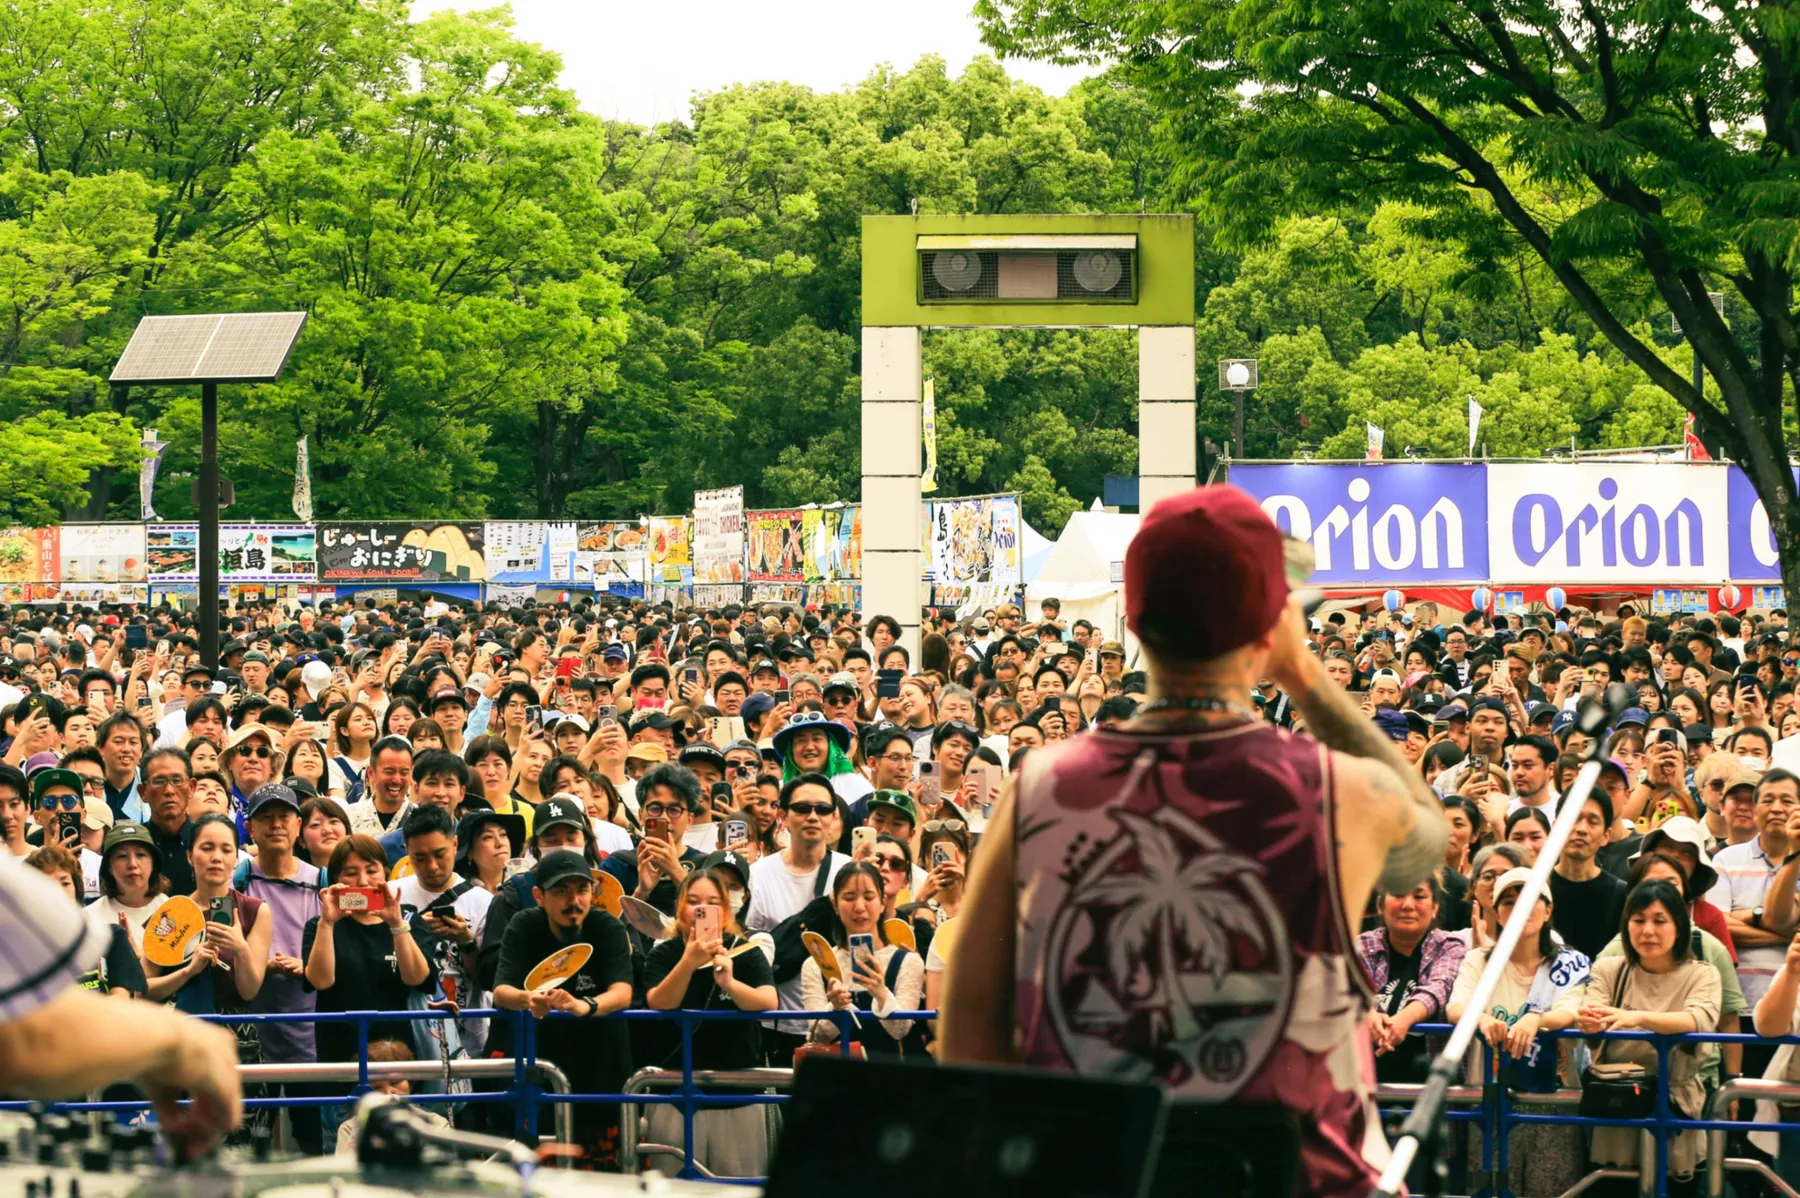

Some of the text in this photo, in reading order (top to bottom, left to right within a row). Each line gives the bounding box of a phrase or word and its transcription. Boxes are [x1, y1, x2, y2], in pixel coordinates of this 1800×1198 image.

[1261, 477, 1465, 571] Orion
[1512, 477, 1705, 568] Orion
[323, 528, 397, 547] じゅーしー
[219, 547, 266, 571] 垣島
[350, 546, 433, 568] おにぎり
[325, 568, 364, 576] OKINAWA
[548, 802, 563, 818] LA
[724, 850, 737, 865] LA
